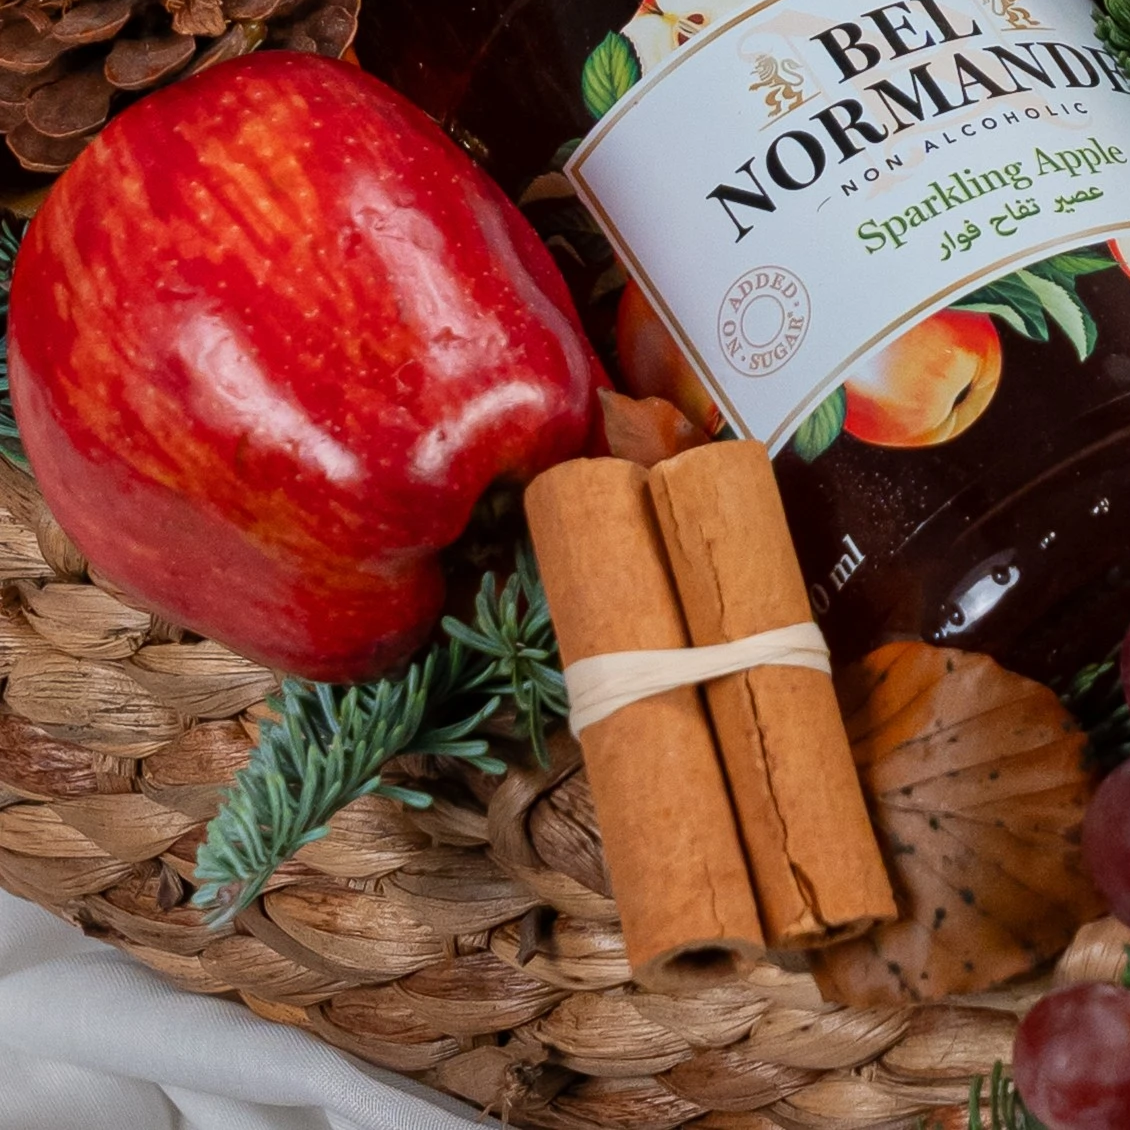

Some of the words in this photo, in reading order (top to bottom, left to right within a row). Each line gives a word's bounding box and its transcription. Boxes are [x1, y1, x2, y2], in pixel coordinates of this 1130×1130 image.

[841, 154, 904, 197] NON
[924, 102, 1088, 154] ALCOHOLIC
[857, 161, 1034, 255] Sparkling
[1033, 137, 1128, 178] Apple
[989, 196, 1041, 237] تفاح
[1053, 185, 1104, 214] عصير
[940, 219, 982, 261] فوار
[728, 272, 798, 314] ADDED
[722, 319, 743, 358] NO
[829, 533, 866, 591] ml
